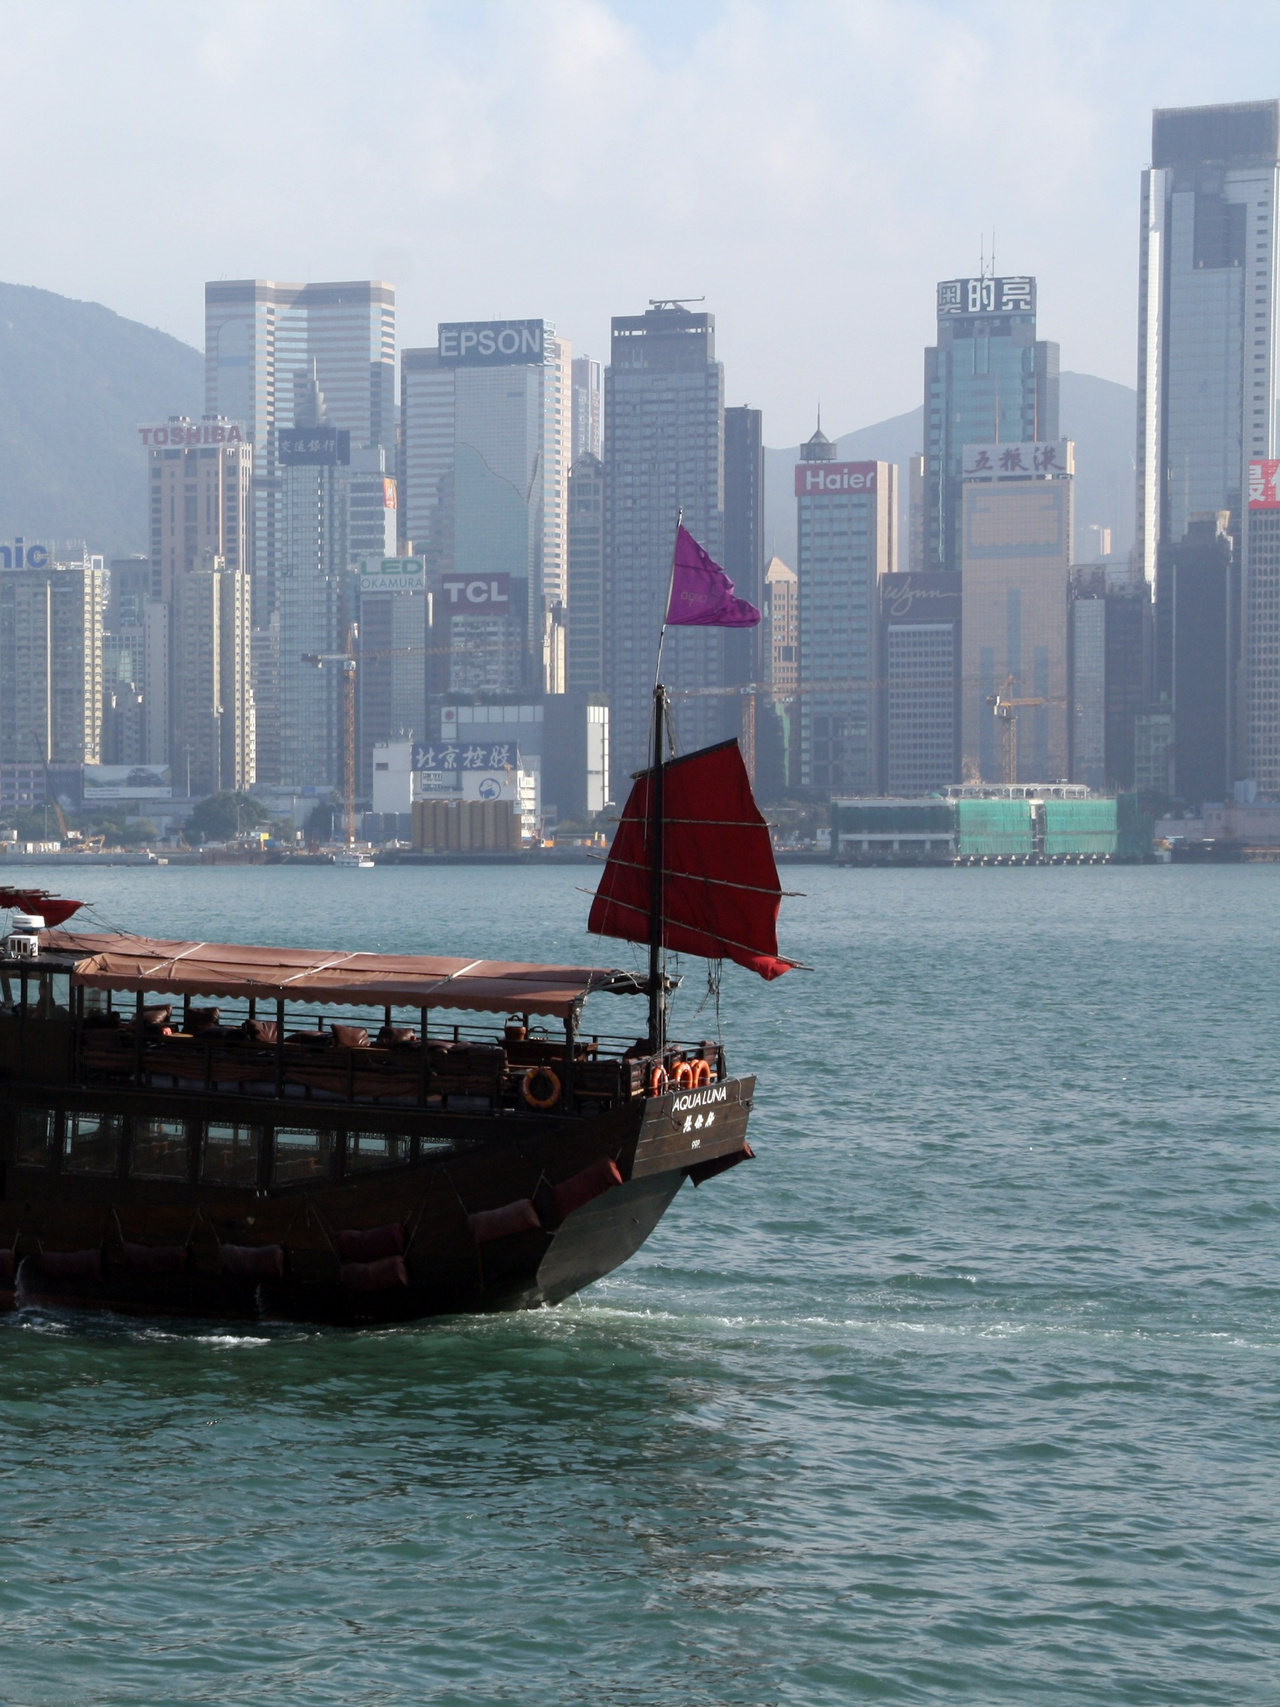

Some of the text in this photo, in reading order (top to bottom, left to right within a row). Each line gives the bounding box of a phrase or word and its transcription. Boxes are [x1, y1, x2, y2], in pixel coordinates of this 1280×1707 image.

[440, 328, 541, 356] EPSON
[138, 425, 243, 446] TOSHIBA
[806, 468, 874, 490] Haier
[360, 559, 423, 575] LED
[361, 577, 424, 589] OKAMURA
[443, 581, 508, 603] TCL
